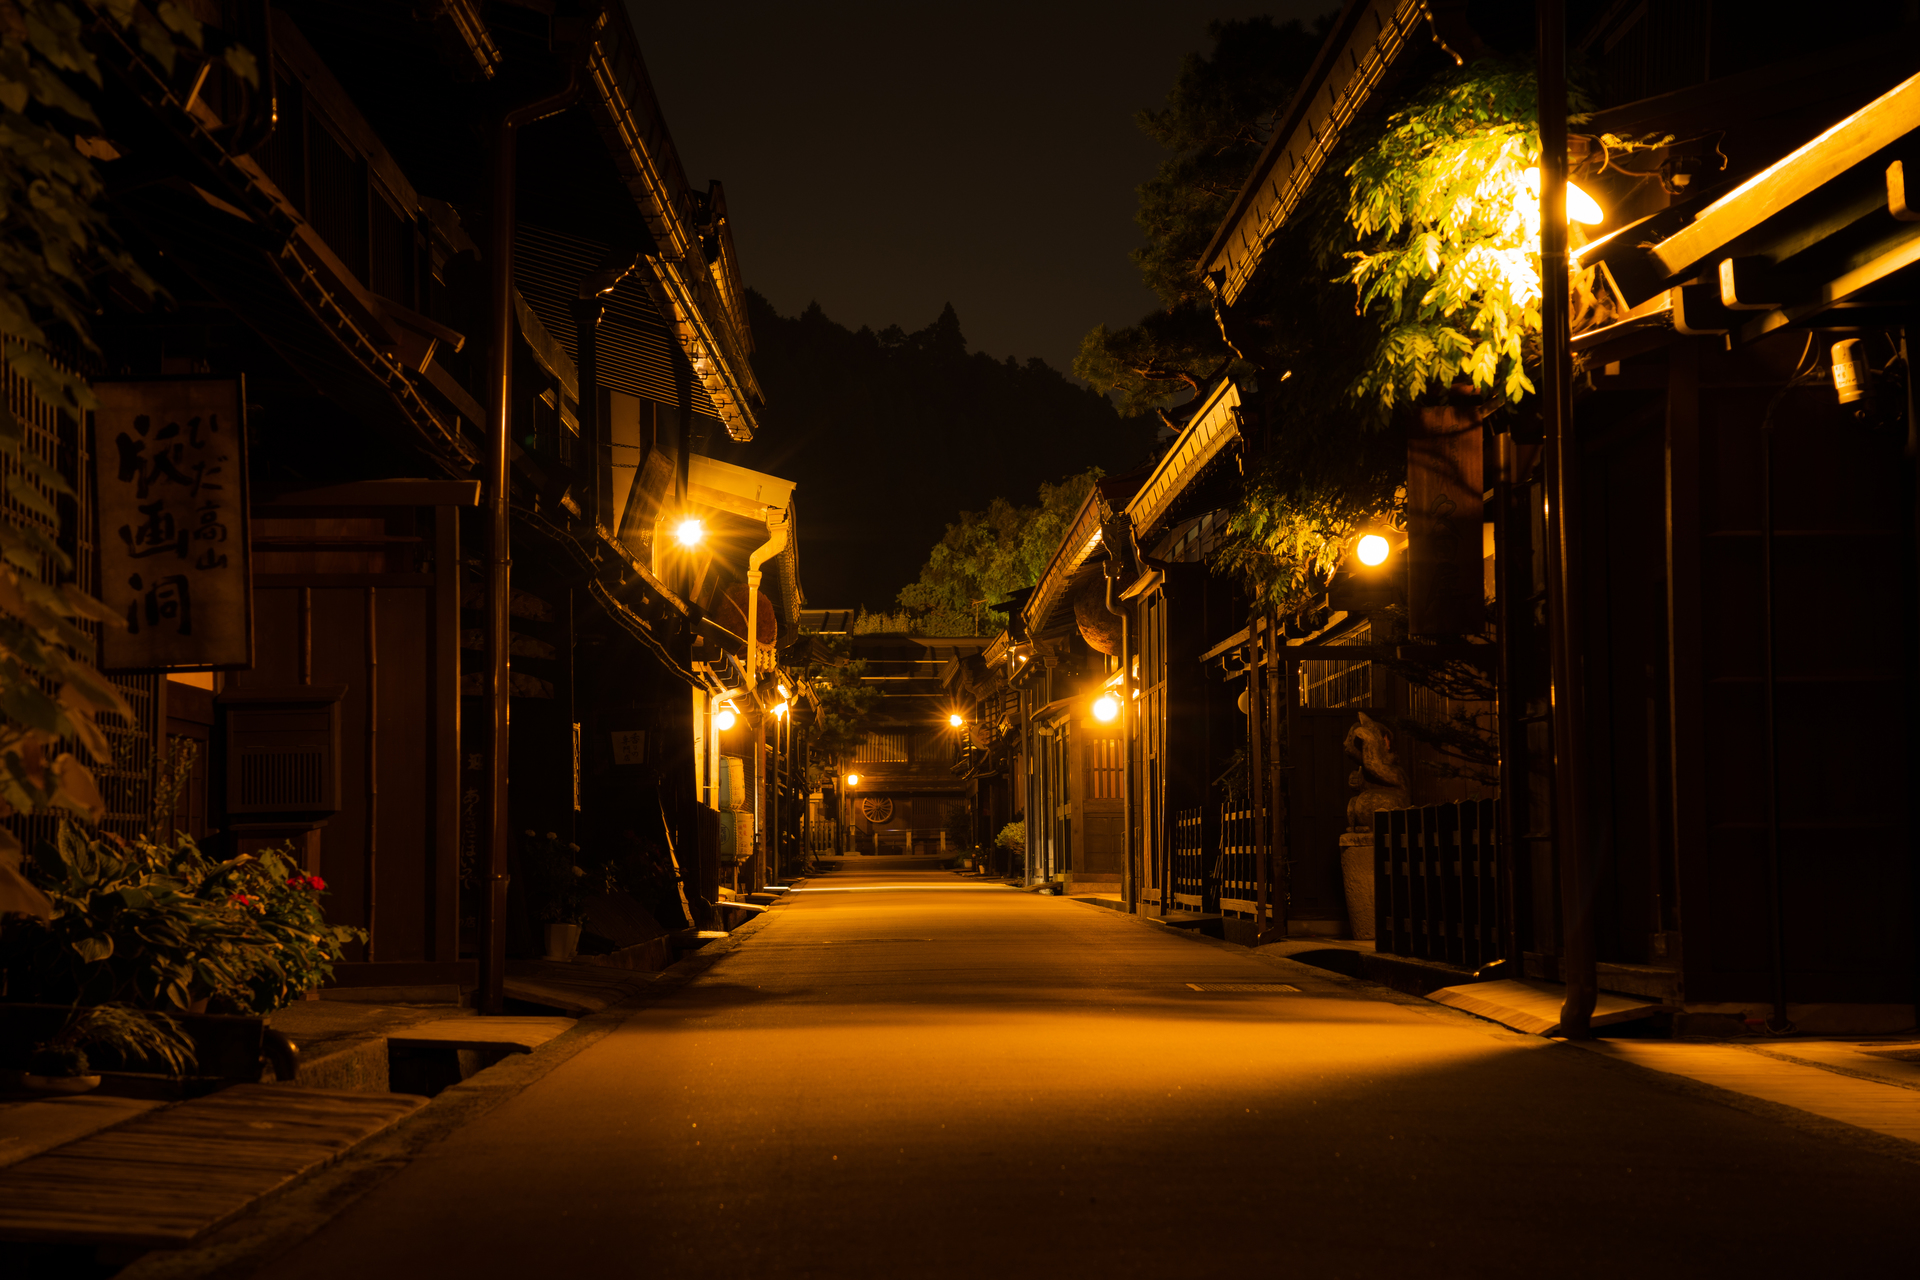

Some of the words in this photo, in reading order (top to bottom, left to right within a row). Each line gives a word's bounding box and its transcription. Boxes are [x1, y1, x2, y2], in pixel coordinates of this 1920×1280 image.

[115, 413, 192, 636] 版画洞
[187, 413, 228, 571] ひだ高山
